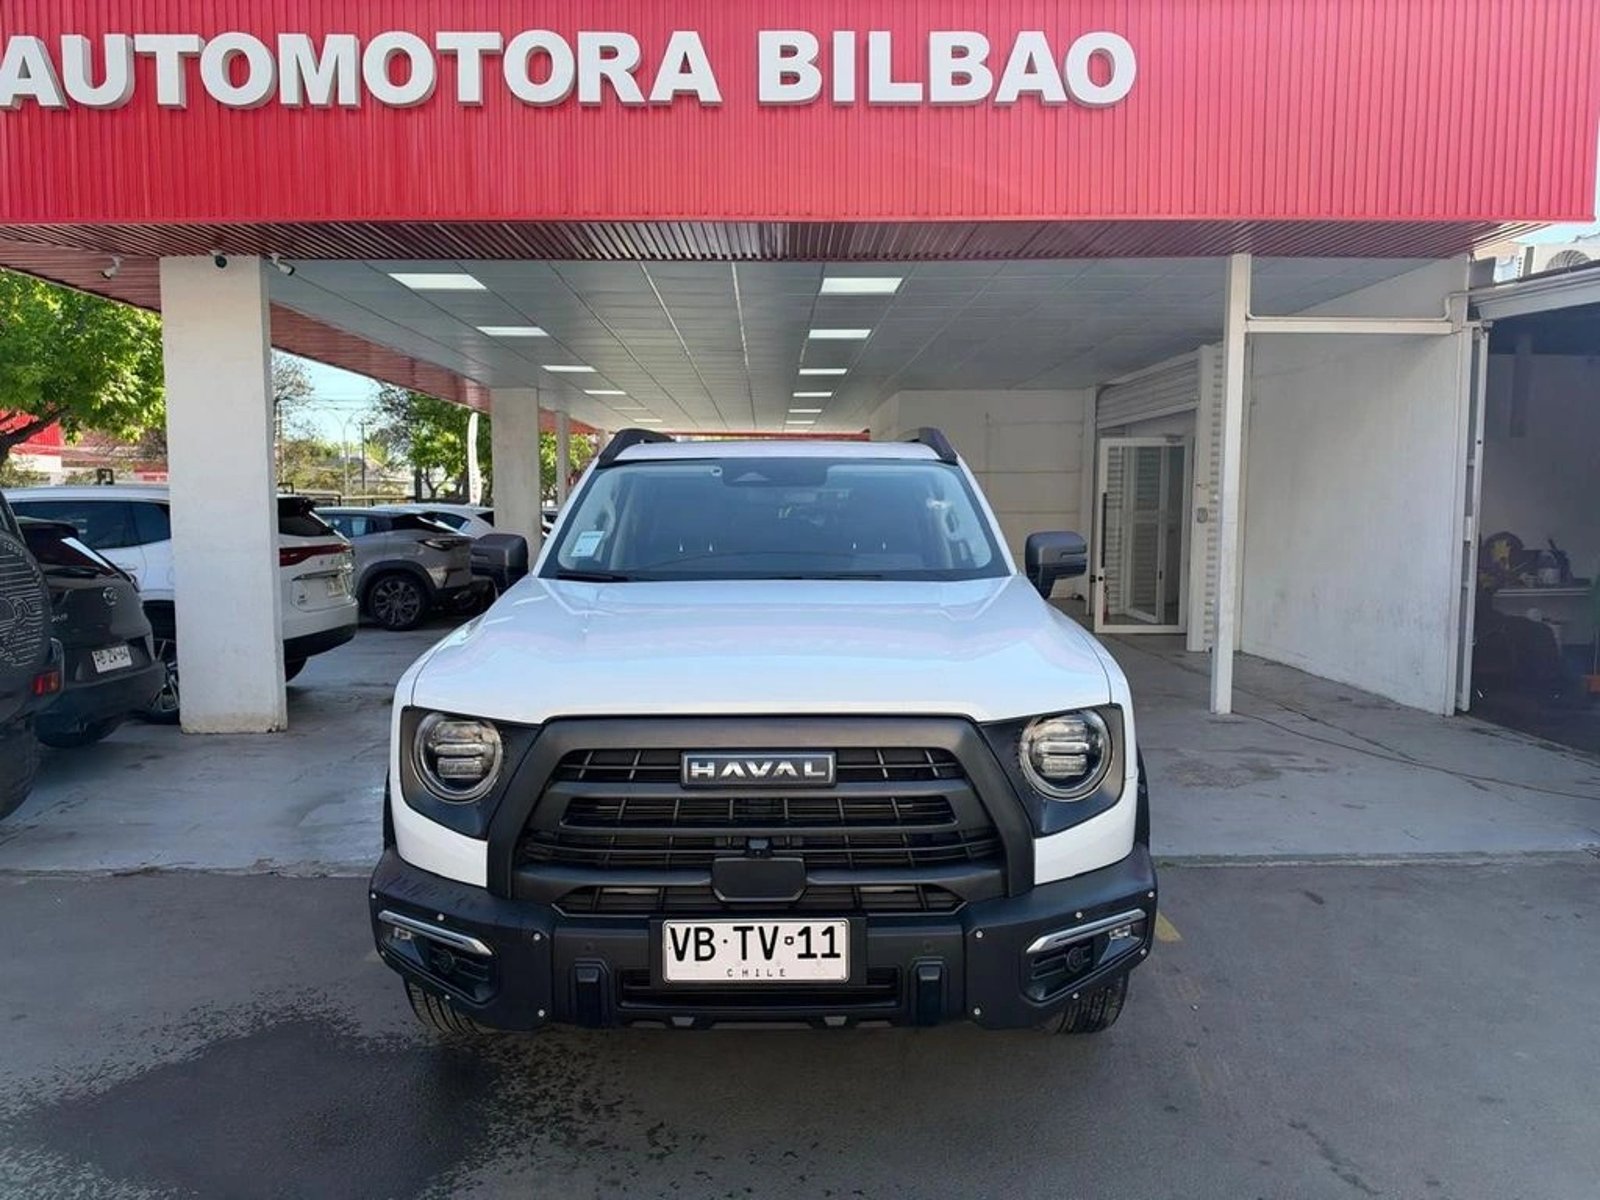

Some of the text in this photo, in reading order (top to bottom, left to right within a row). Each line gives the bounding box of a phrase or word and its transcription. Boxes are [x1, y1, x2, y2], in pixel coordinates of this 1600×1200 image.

[0, 30, 1137, 109] AUTOMOTORA BILBAO
[690, 761, 826, 777] HAVAL
[726, 968, 786, 978] CHILE
